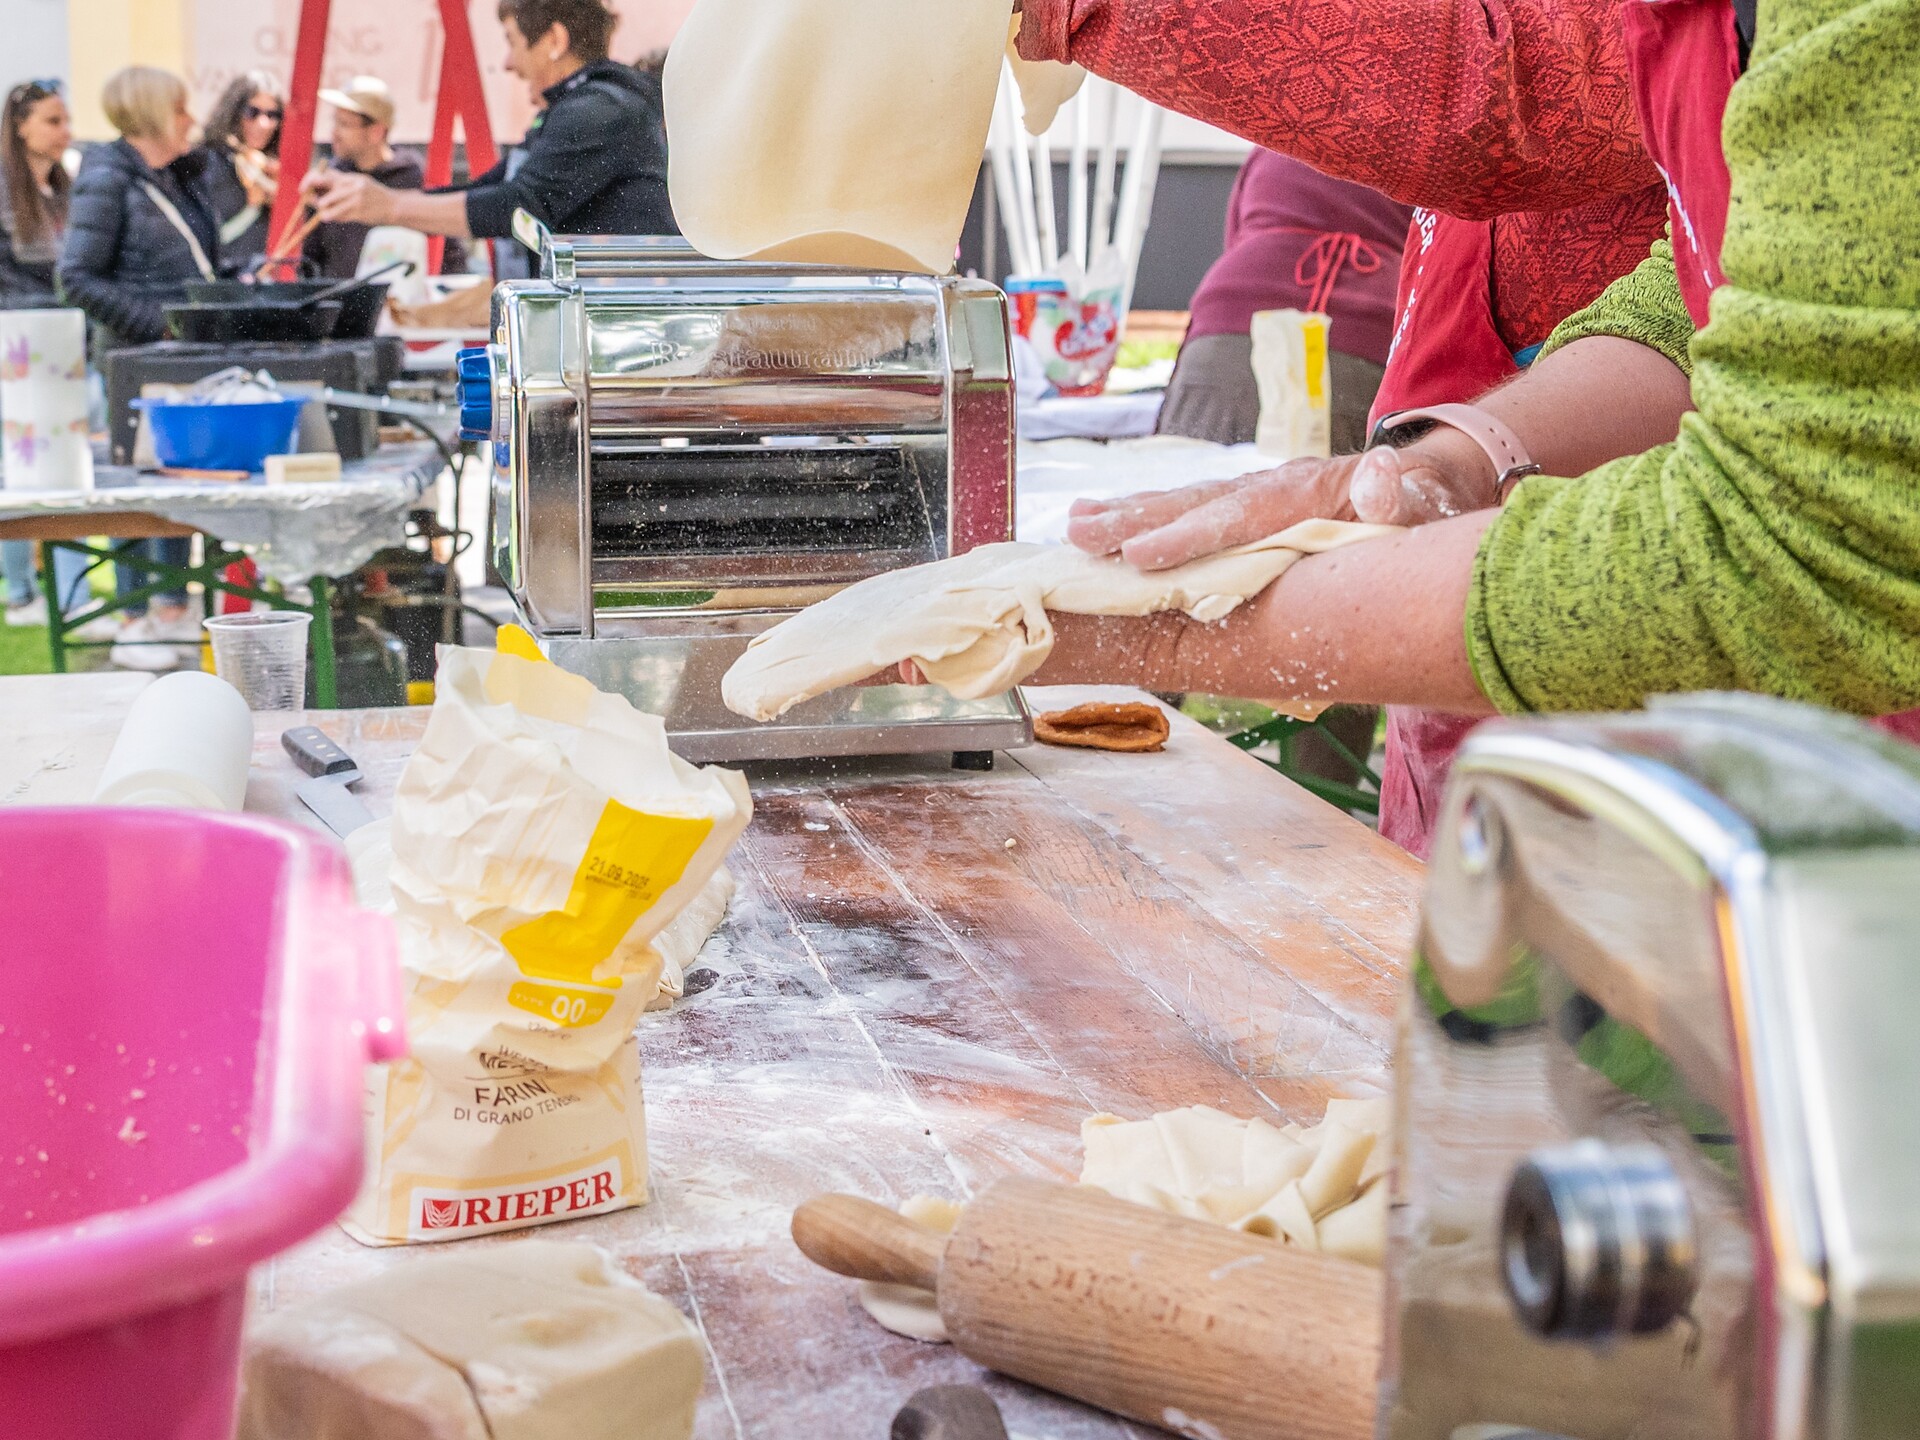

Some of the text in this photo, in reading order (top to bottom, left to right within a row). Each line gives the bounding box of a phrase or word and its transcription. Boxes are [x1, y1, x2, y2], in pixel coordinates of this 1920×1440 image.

[453, 1106, 471, 1121] DI
[477, 1106, 534, 1125] GRANO
[462, 1171, 616, 1227] RIEPER
